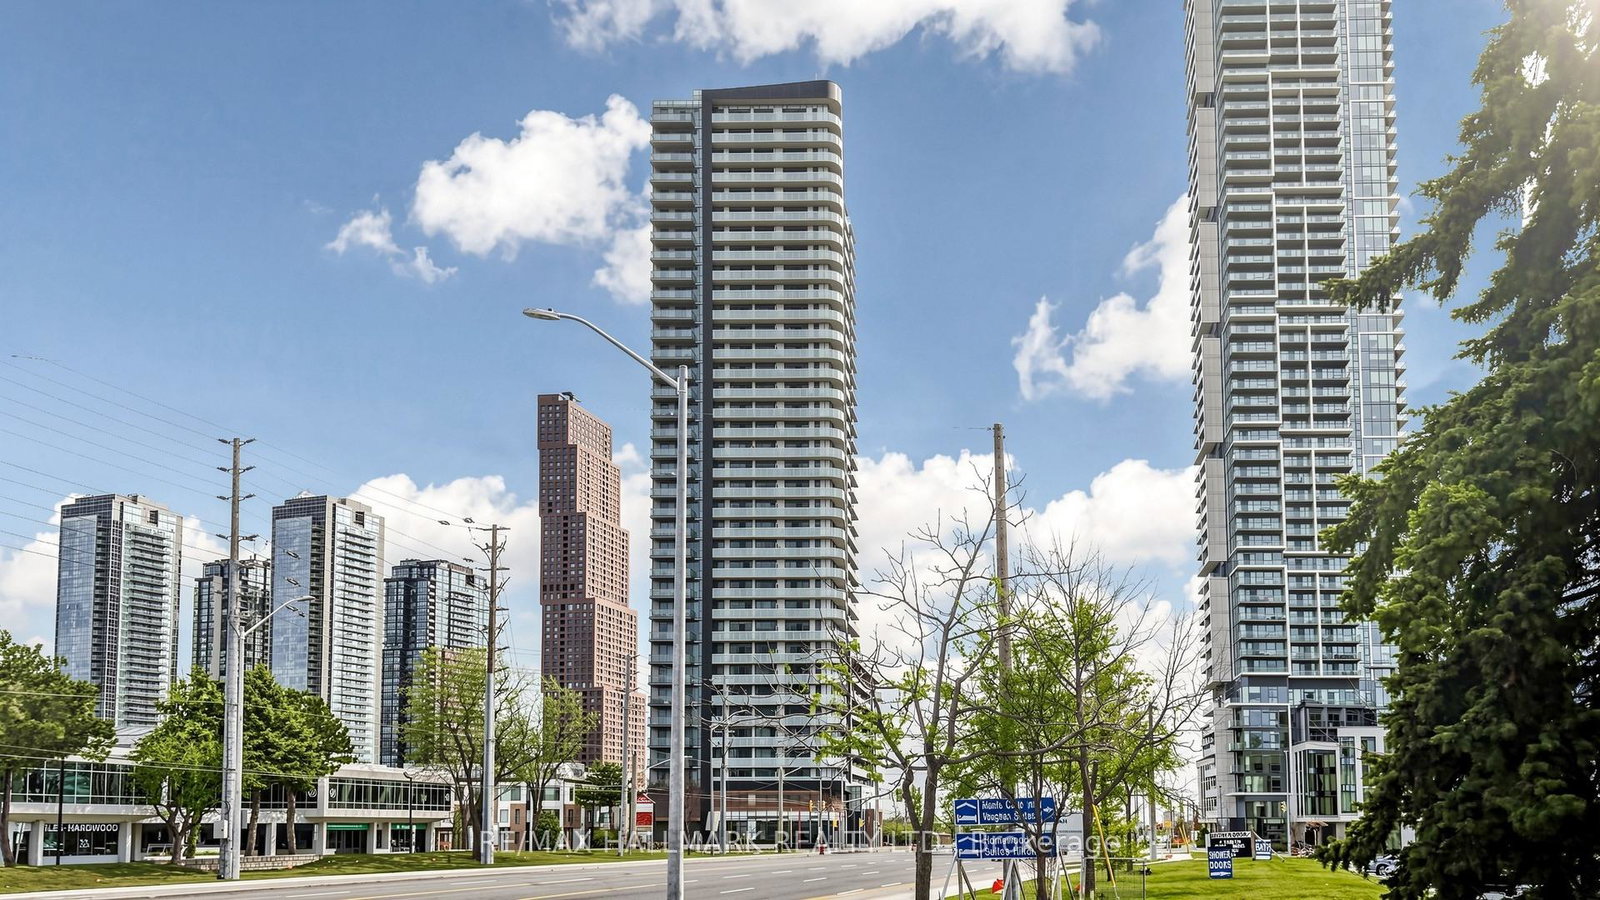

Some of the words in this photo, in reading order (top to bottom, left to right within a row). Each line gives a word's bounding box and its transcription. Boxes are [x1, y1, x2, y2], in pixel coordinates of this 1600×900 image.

[1005, 800, 1024, 810] Calo
[984, 847, 1009, 856] Suites
[1209, 851, 1231, 859] SHOWER
[1210, 861, 1231, 869] DOORS
